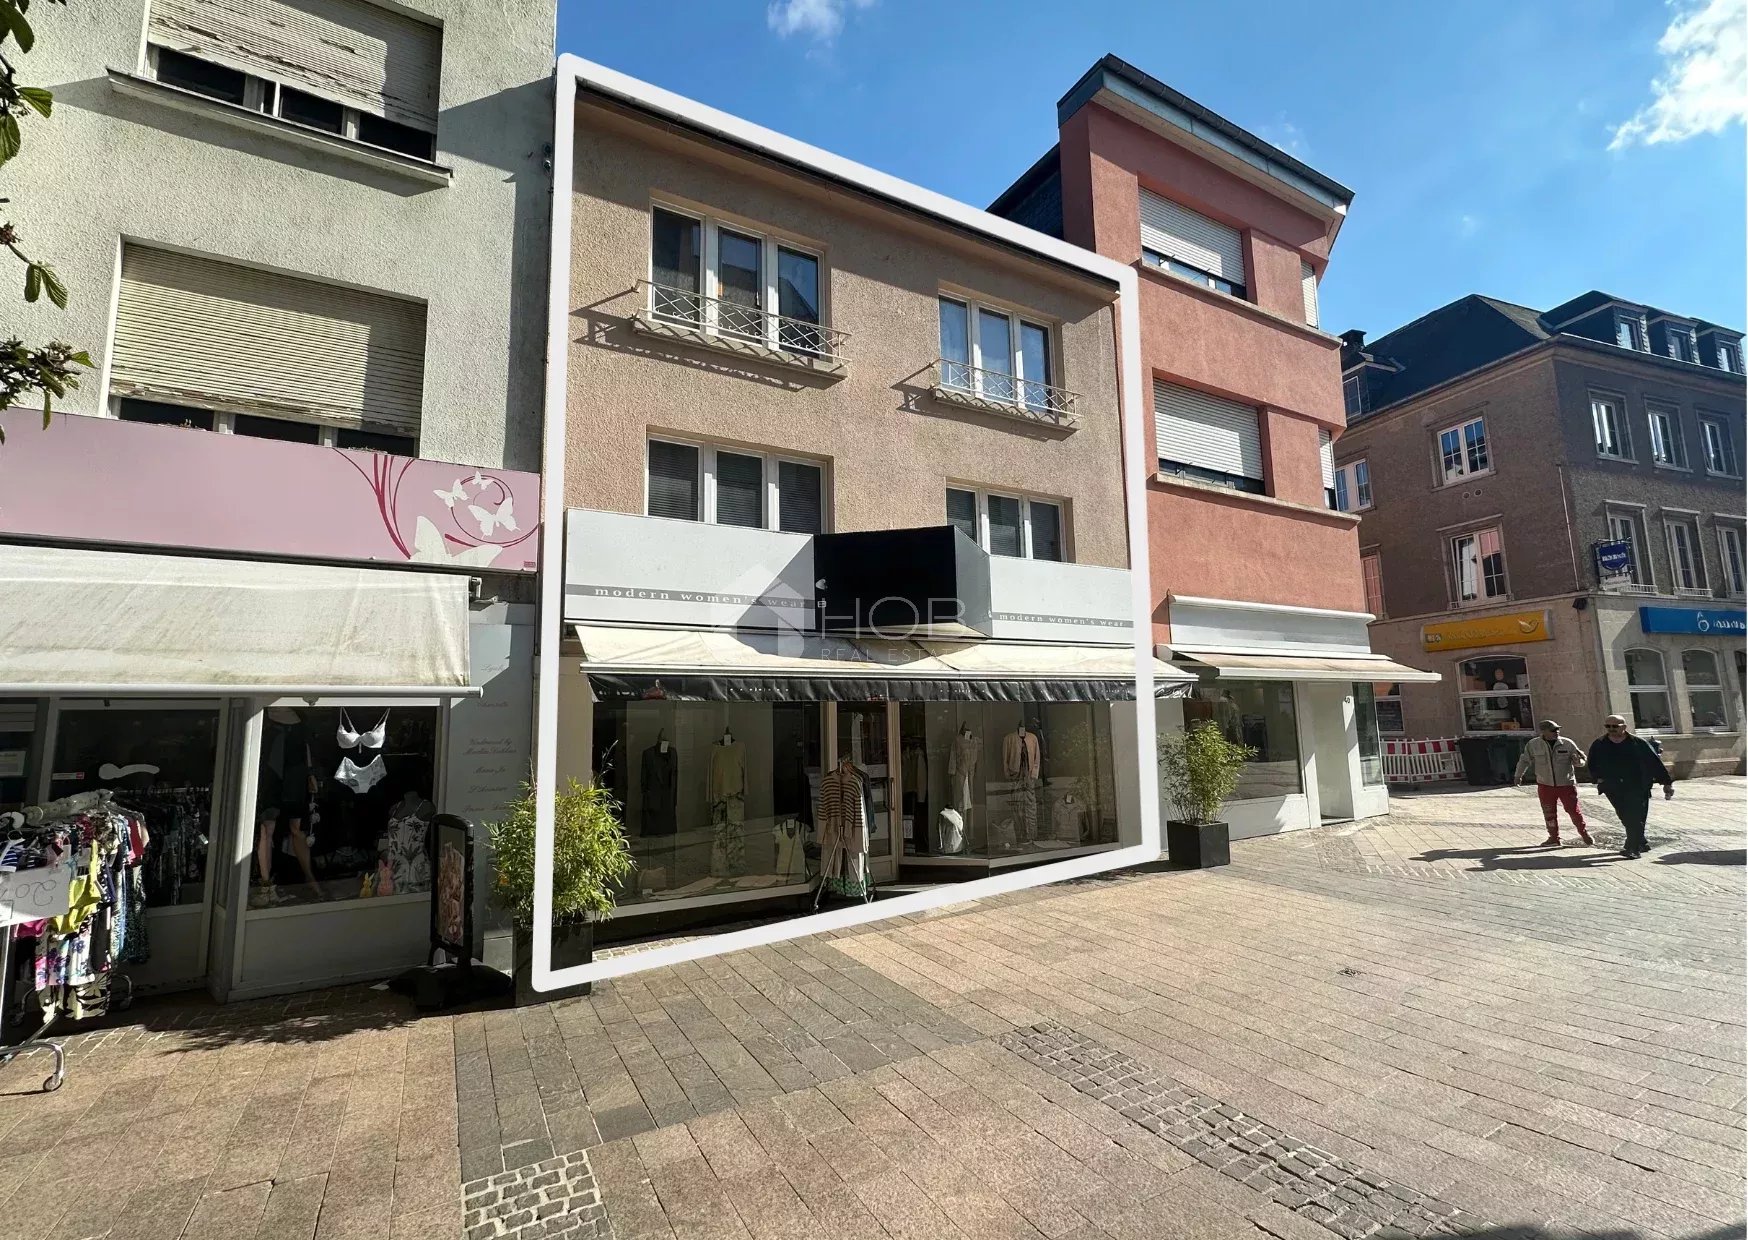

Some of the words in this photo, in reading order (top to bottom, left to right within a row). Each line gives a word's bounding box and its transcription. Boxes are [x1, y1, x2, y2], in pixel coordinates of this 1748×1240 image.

[595, 588, 669, 600] modern
[681, 592, 757, 605] women's
[767, 598, 806, 608] wear
[999, 613, 1043, 622] modern
[1049, 616, 1095, 626] women's
[1100, 620, 1124, 628] wear
